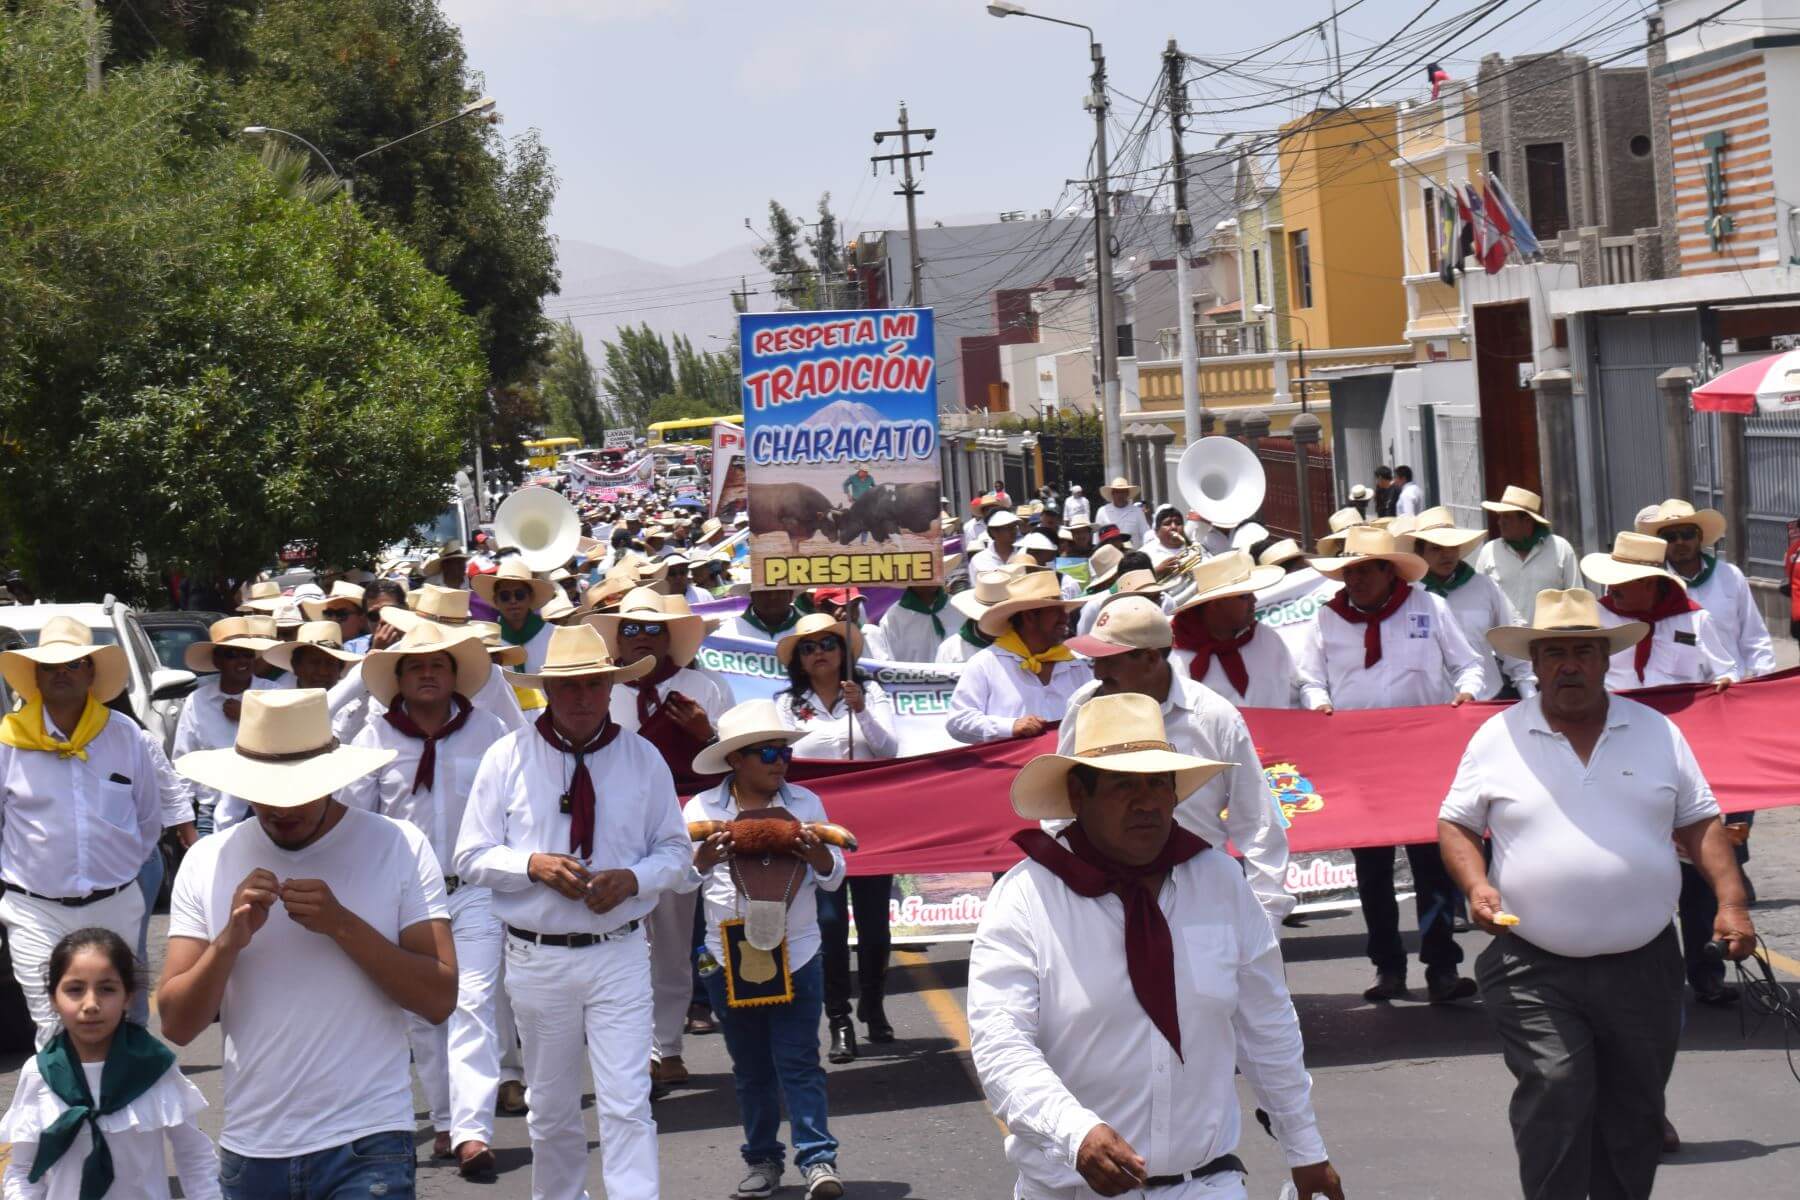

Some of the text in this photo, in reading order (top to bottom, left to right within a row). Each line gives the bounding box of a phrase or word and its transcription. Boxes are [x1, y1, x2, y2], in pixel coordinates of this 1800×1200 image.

[754, 314, 917, 355] RESPETA MI
[746, 342, 933, 408] TRADICIÓN
[753, 422, 934, 464] CHARACATO
[765, 552, 932, 586] PRESENTE
